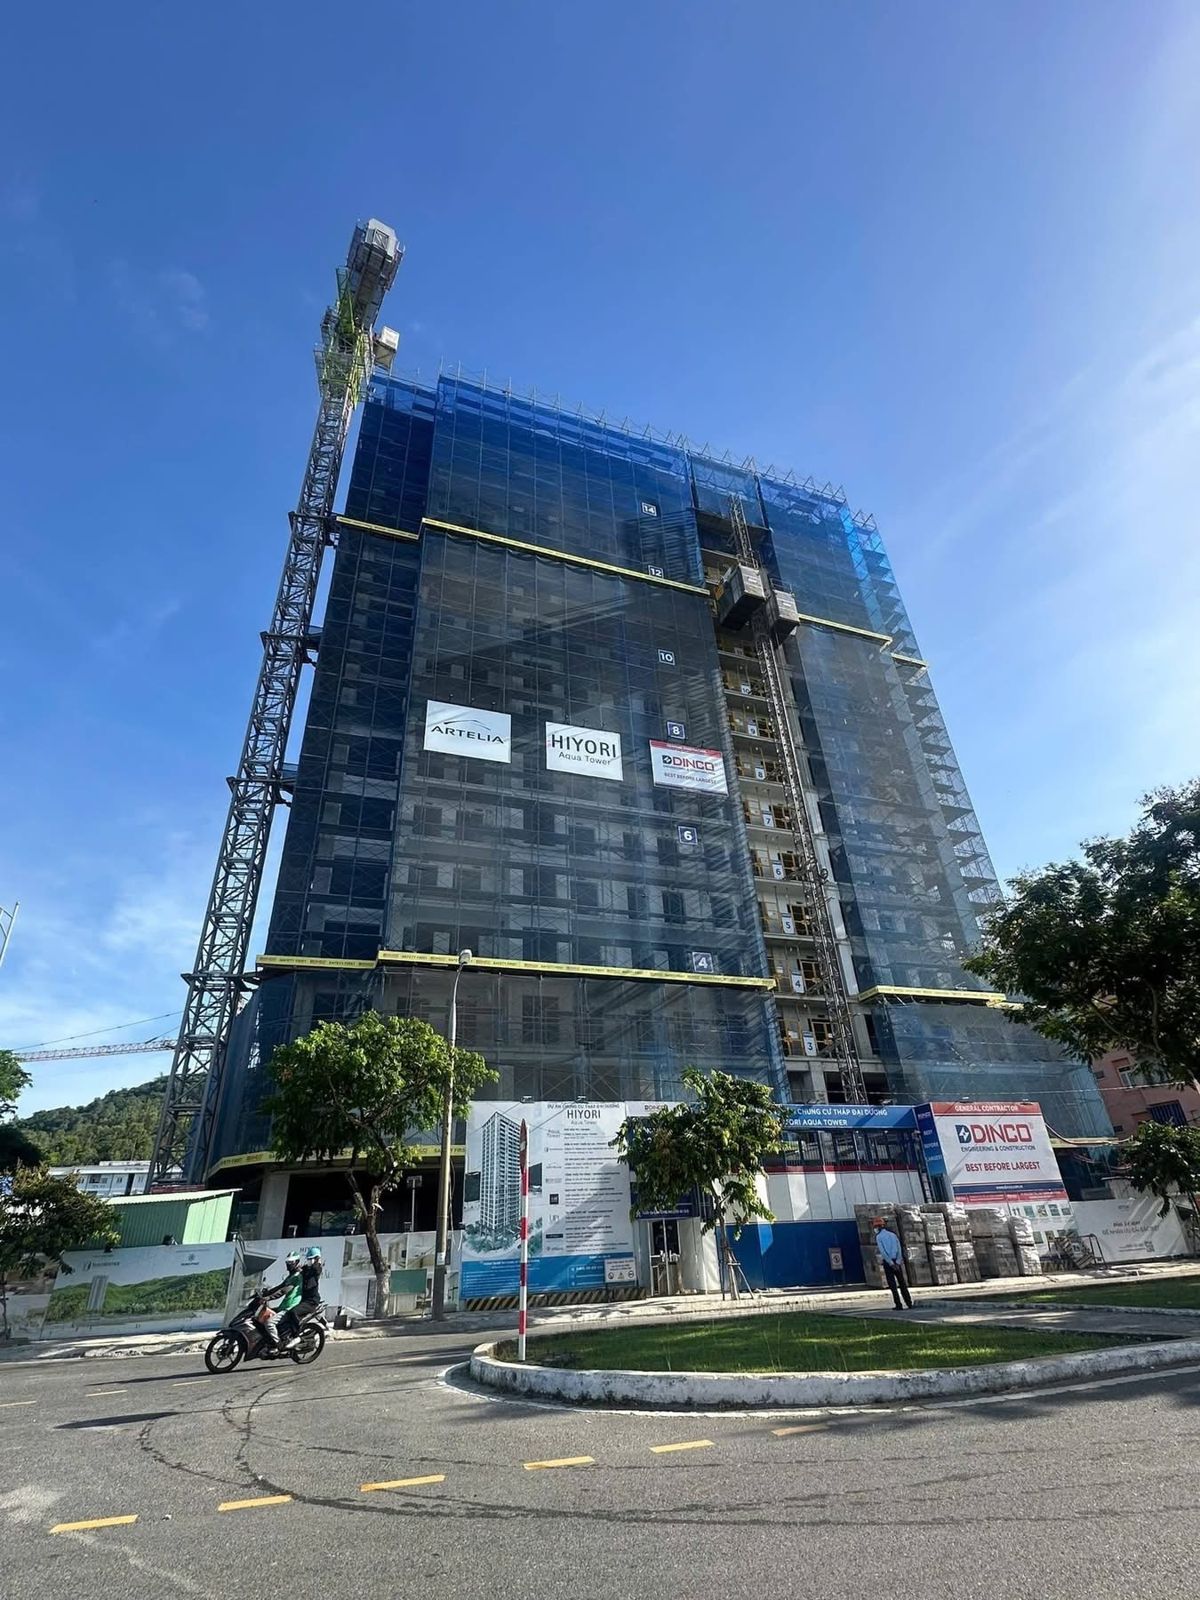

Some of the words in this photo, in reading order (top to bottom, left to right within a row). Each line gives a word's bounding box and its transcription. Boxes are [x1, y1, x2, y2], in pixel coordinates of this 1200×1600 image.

[643, 505, 655, 514] 14
[650, 568, 662, 577] 12
[660, 652, 673, 662] 10
[431, 726, 504, 744] ARTELIA
[672, 726, 680, 735] 8
[551, 734, 617, 758] HIYORI
[558, 751, 582, 763] Aqua
[584, 755, 611, 766] Tower
[673, 757, 714, 771] DINCO
[684, 831, 692, 841] 6
[698, 957, 708, 968] 4
[954, 1104, 981, 1112] GENERAL
[982, 1104, 1019, 1112] CONTRACTOR
[567, 1109, 601, 1119] HIYORI
[970, 1124, 1033, 1143] DINCO
[999, 1144, 1036, 1152] CONSTRUCTION
[965, 1163, 983, 1172] BEST
[984, 1162, 1011, 1171] BEFORE
[1011, 1161, 1040, 1170] LARGEST
